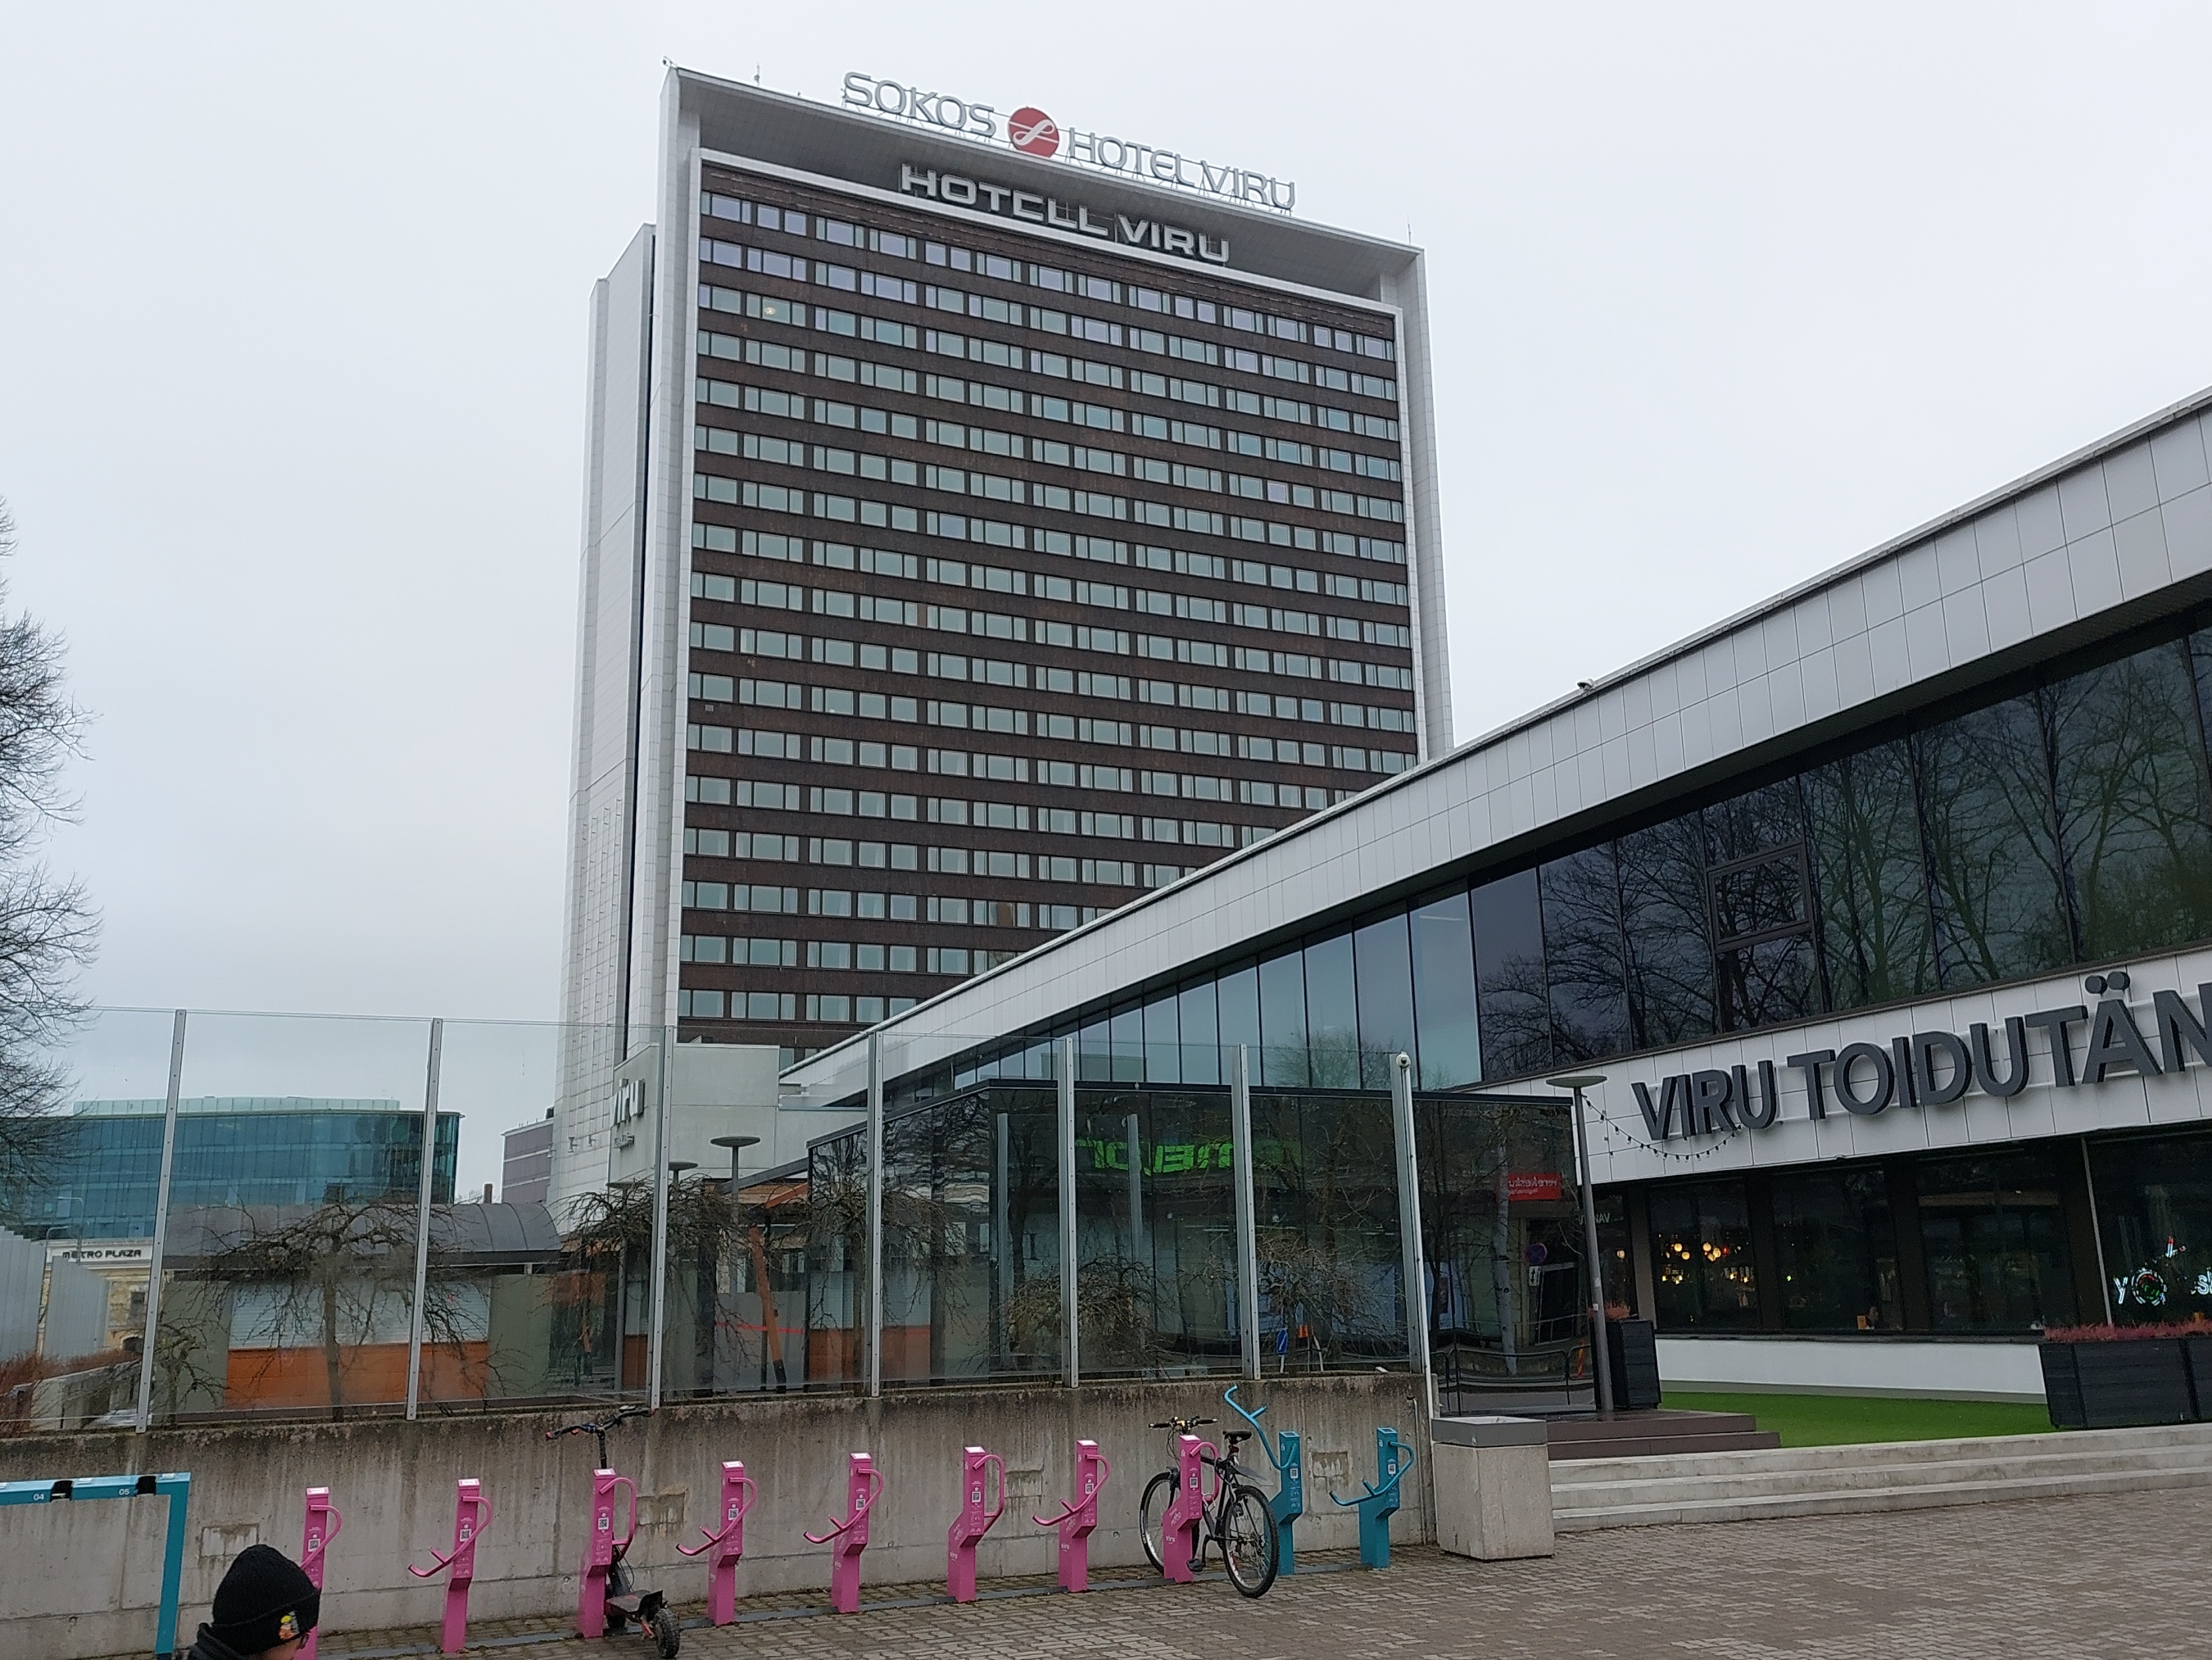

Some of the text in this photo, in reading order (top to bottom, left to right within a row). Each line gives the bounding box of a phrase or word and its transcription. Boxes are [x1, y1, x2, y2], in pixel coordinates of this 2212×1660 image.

[843, 71, 1296, 210] SOKOS HOTEL VIRU
[900, 162, 1230, 264] HOTELL VIRU
[1631, 971, 2212, 1141] VIRU TOIDUTÄN
[62, 1249, 142, 1259] METRO PLAZA
[33, 1492, 45, 1501] 04
